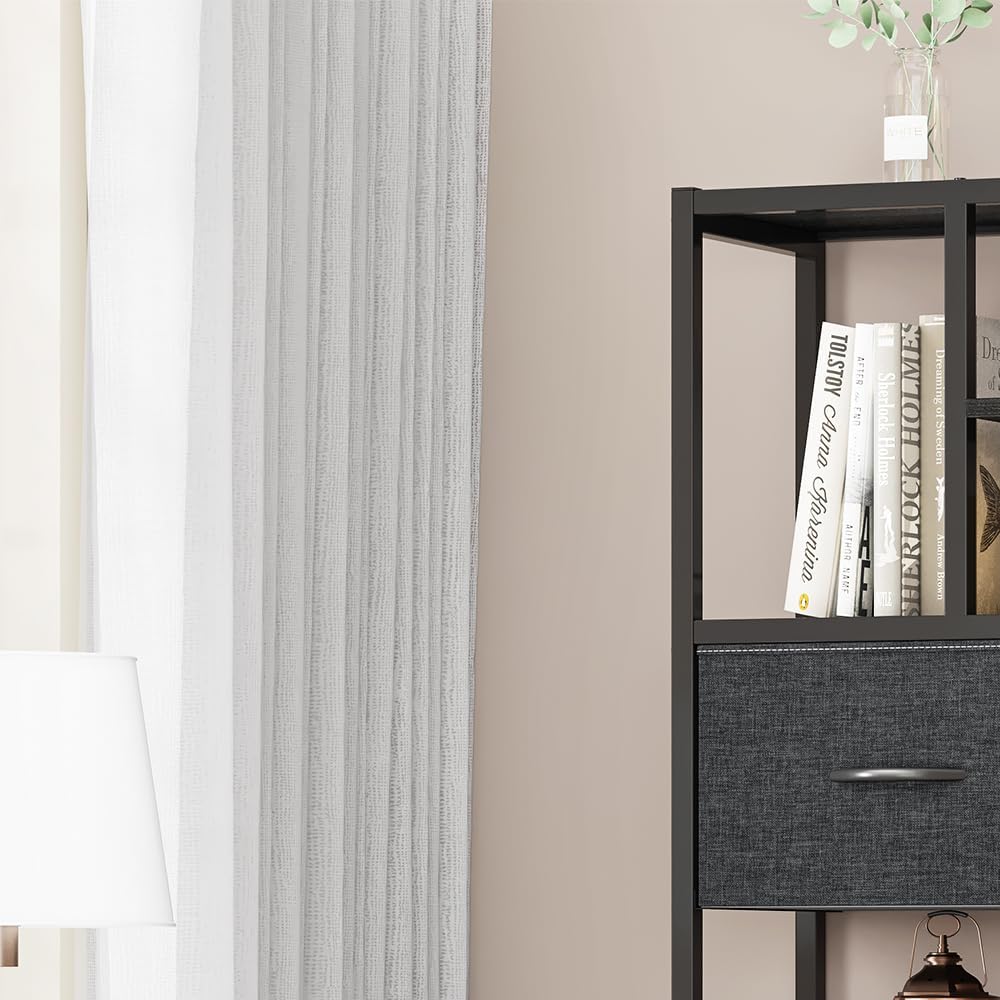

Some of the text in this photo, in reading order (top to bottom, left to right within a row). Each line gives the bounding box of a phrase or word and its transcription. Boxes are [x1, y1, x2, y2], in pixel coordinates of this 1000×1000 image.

[878, 372, 896, 488] Sherlock Holmes
[933, 350, 945, 465] Dreaming of Sweden
[988, 375, 996, 391] of
[801, 334, 848, 583] TOLSTOY Anna Karenina
[936, 534, 945, 600] Andrew Brown
